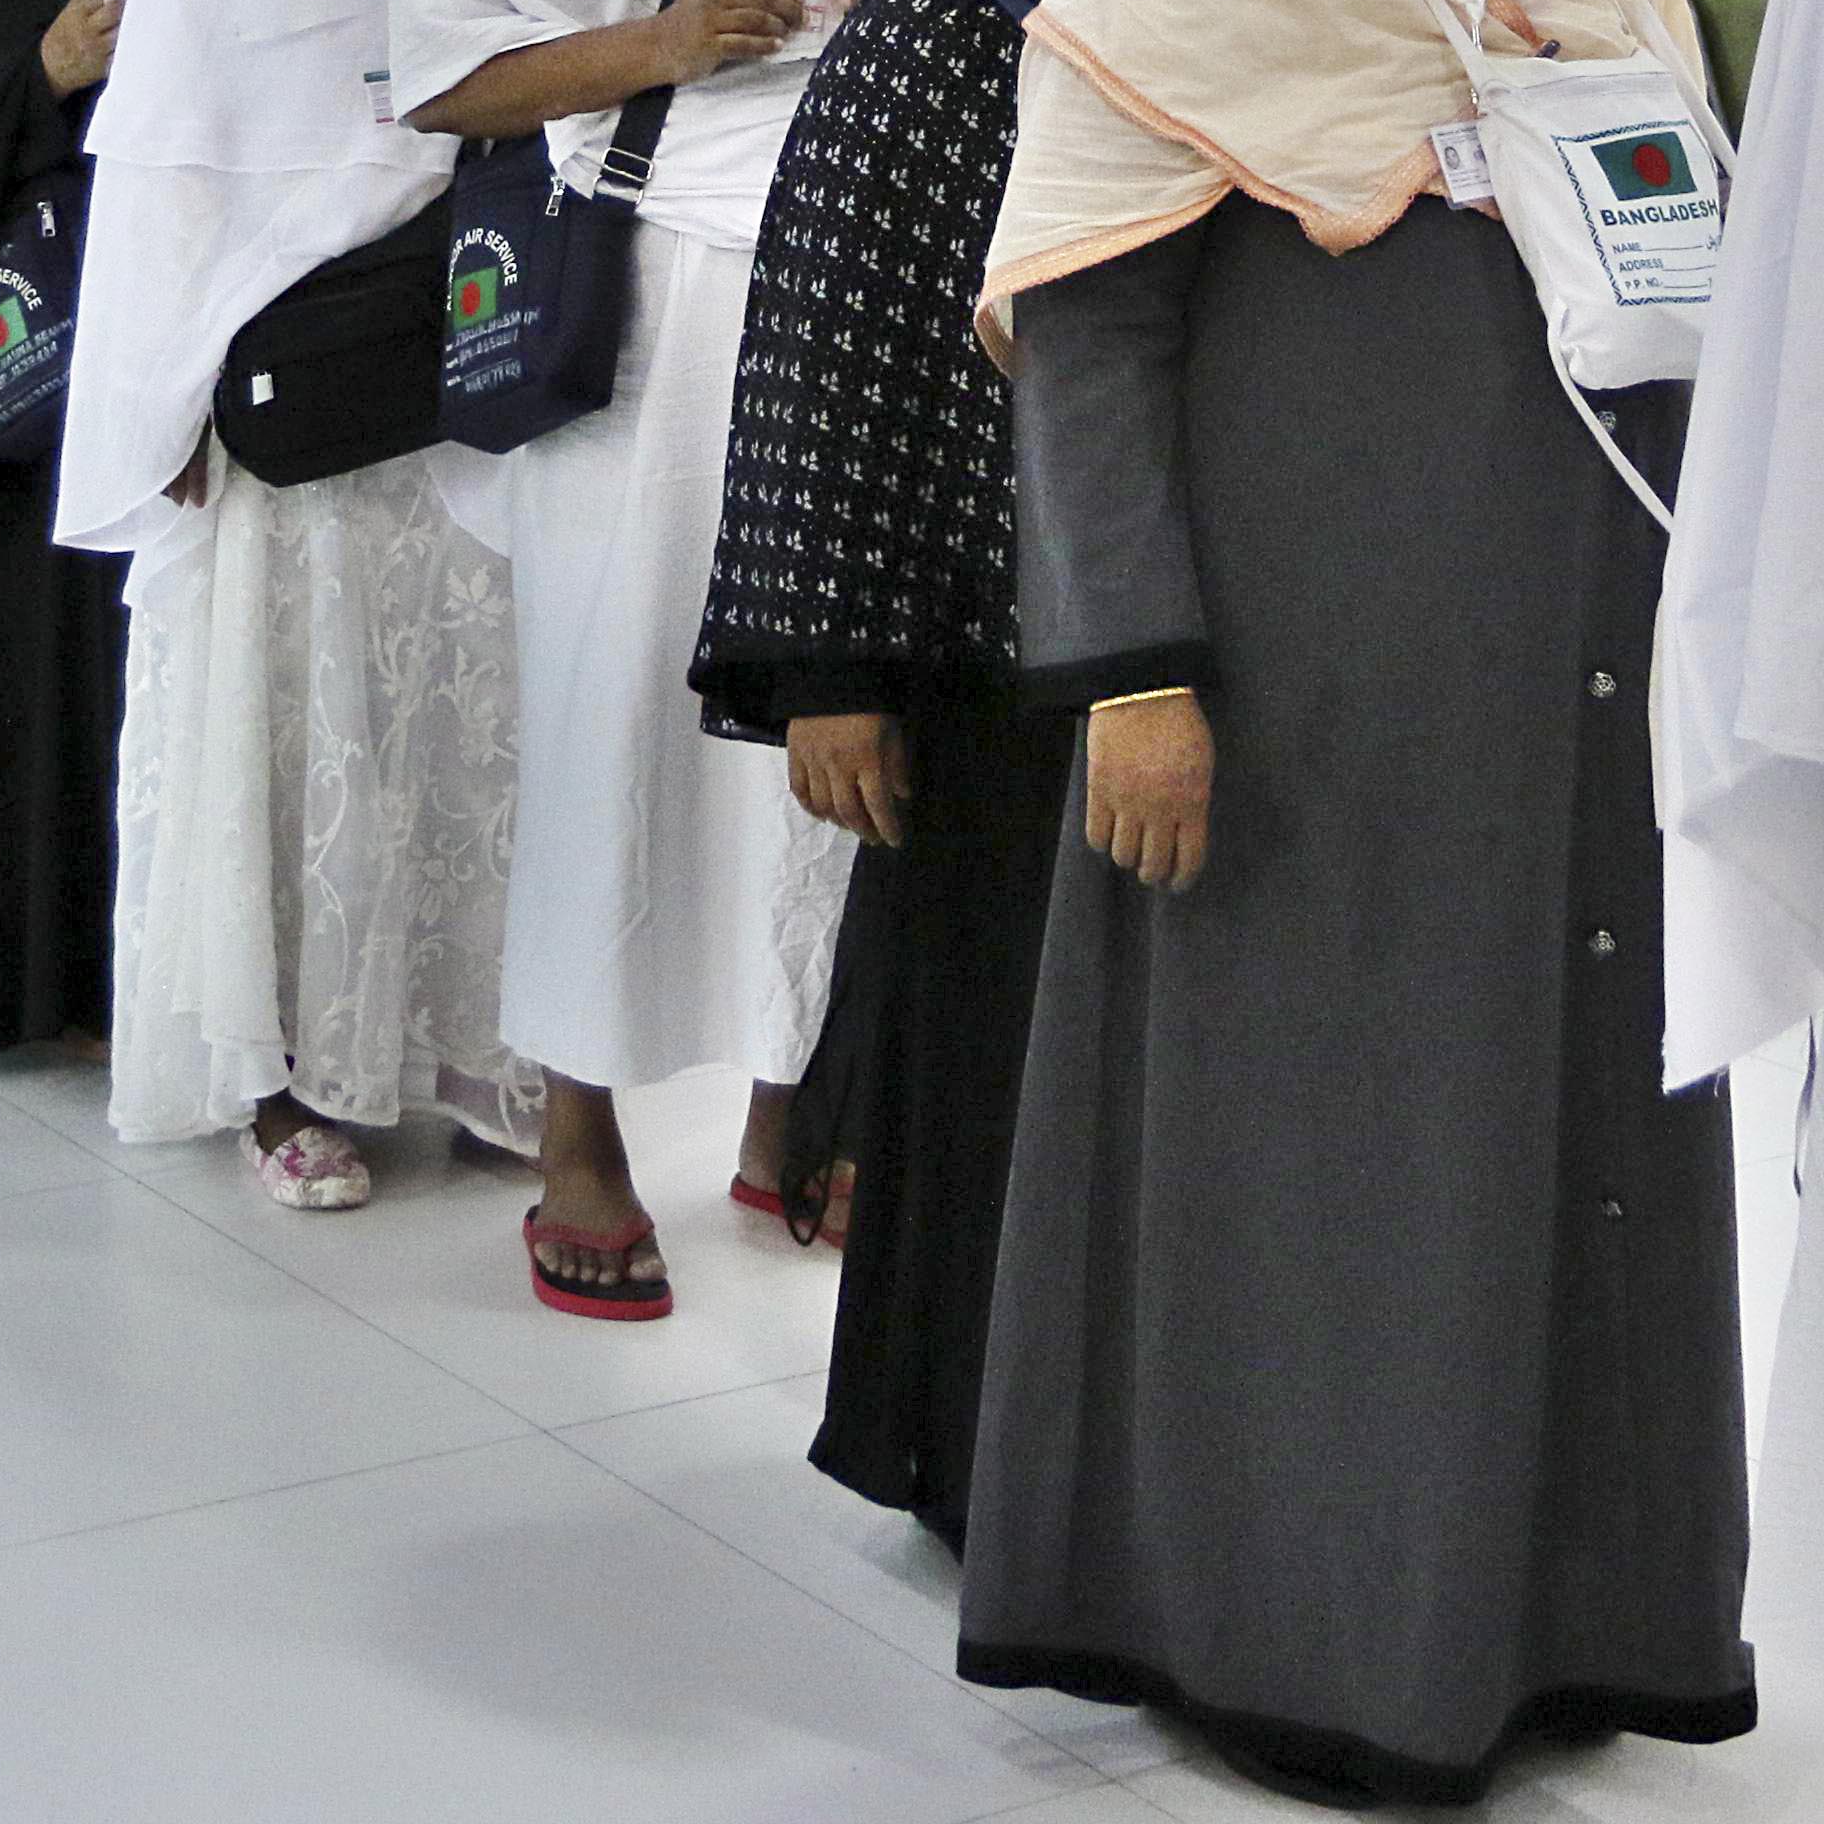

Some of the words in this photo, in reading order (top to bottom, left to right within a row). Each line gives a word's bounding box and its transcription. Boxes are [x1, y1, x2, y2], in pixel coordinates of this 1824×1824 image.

[1600, 199, 1719, 226] BANGLADESH
[464, 227, 484, 248] AIR
[484, 230, 518, 287] SERVICE
[1612, 242, 1640, 255] NAME
[1619, 258, 1664, 273] ADDRESS
